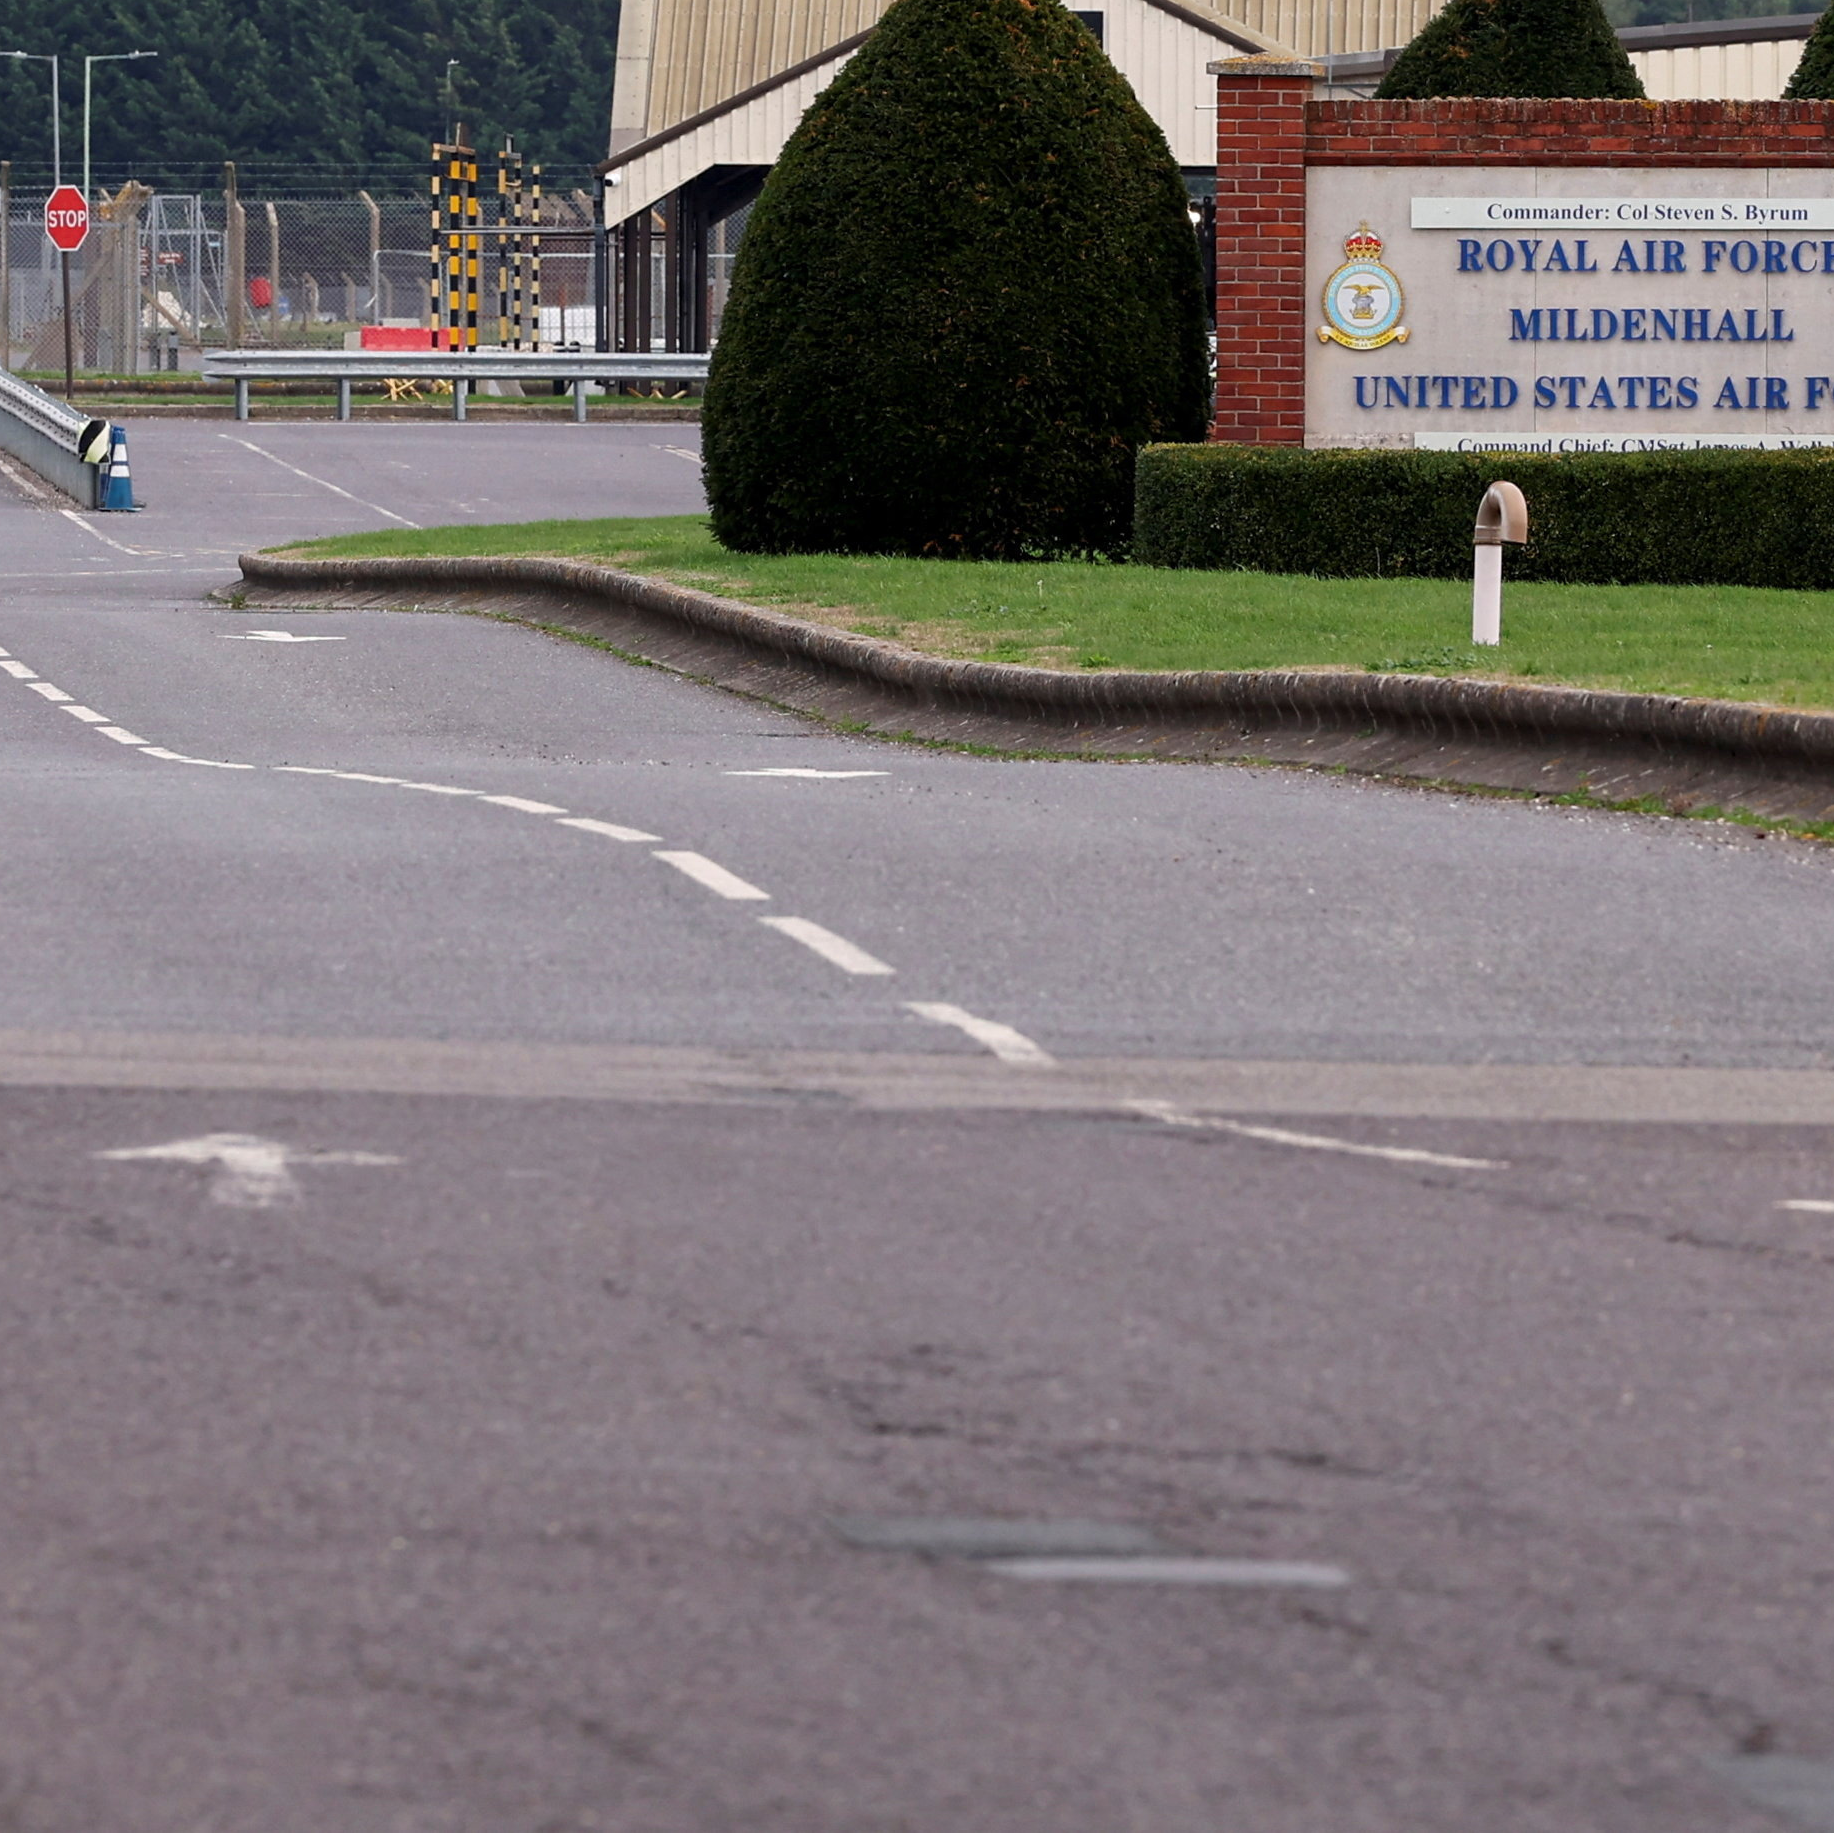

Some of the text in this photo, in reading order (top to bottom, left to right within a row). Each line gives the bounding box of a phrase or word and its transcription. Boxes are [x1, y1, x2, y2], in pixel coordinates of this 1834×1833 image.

[48, 210, 86, 228] STOP
[1487, 203, 1808, 225] Commander: Col Steven S. Byrum
[1457, 239, 1597, 272] ROYAL
[1612, 239, 1686, 273] AIR
[1510, 308, 1795, 342] MILDENHALL
[1354, 375, 1519, 409] UNITED
[1534, 376, 1699, 410] STATES
[1713, 376, 1789, 410] AIR
[1457, 438, 1552, 453] Command
